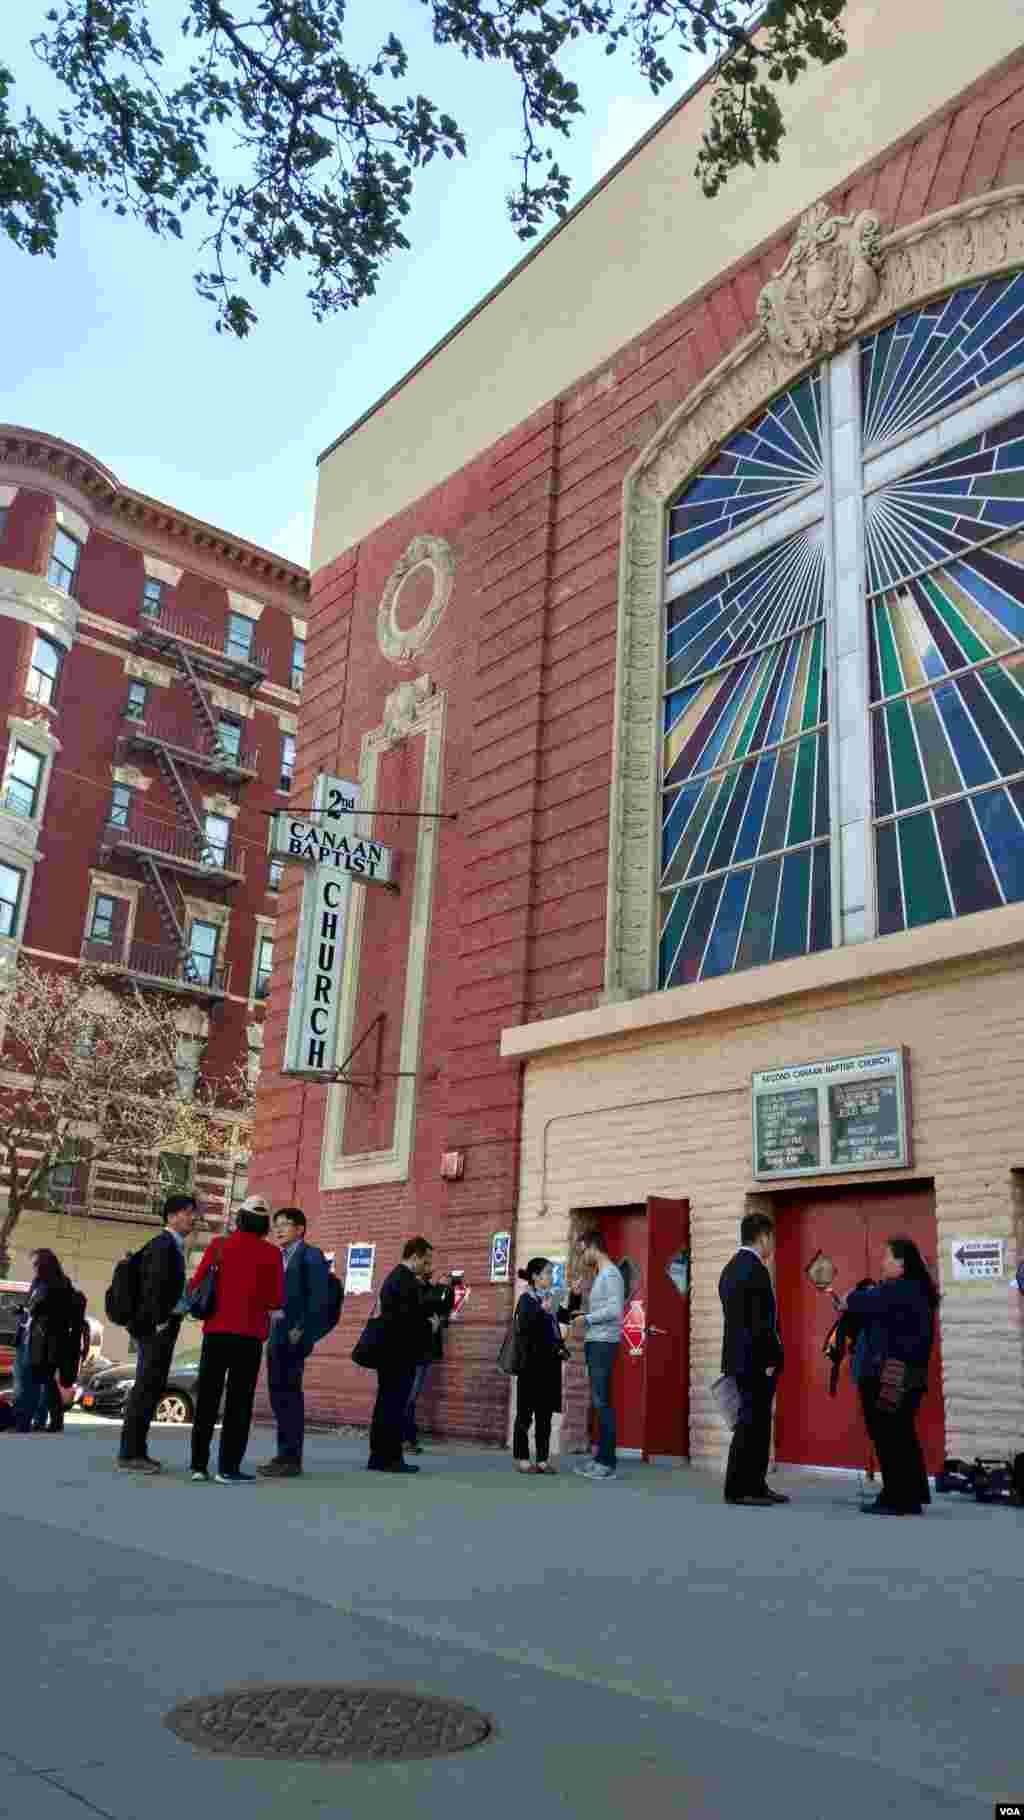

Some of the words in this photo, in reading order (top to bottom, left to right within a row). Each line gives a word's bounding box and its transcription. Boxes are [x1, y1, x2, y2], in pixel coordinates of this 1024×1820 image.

[328, 790, 354, 819] 2nd
[289, 838, 378, 876] BAPTIST
[290, 822, 382, 862] CANAAN
[306, 881, 341, 1068] CHURCH
